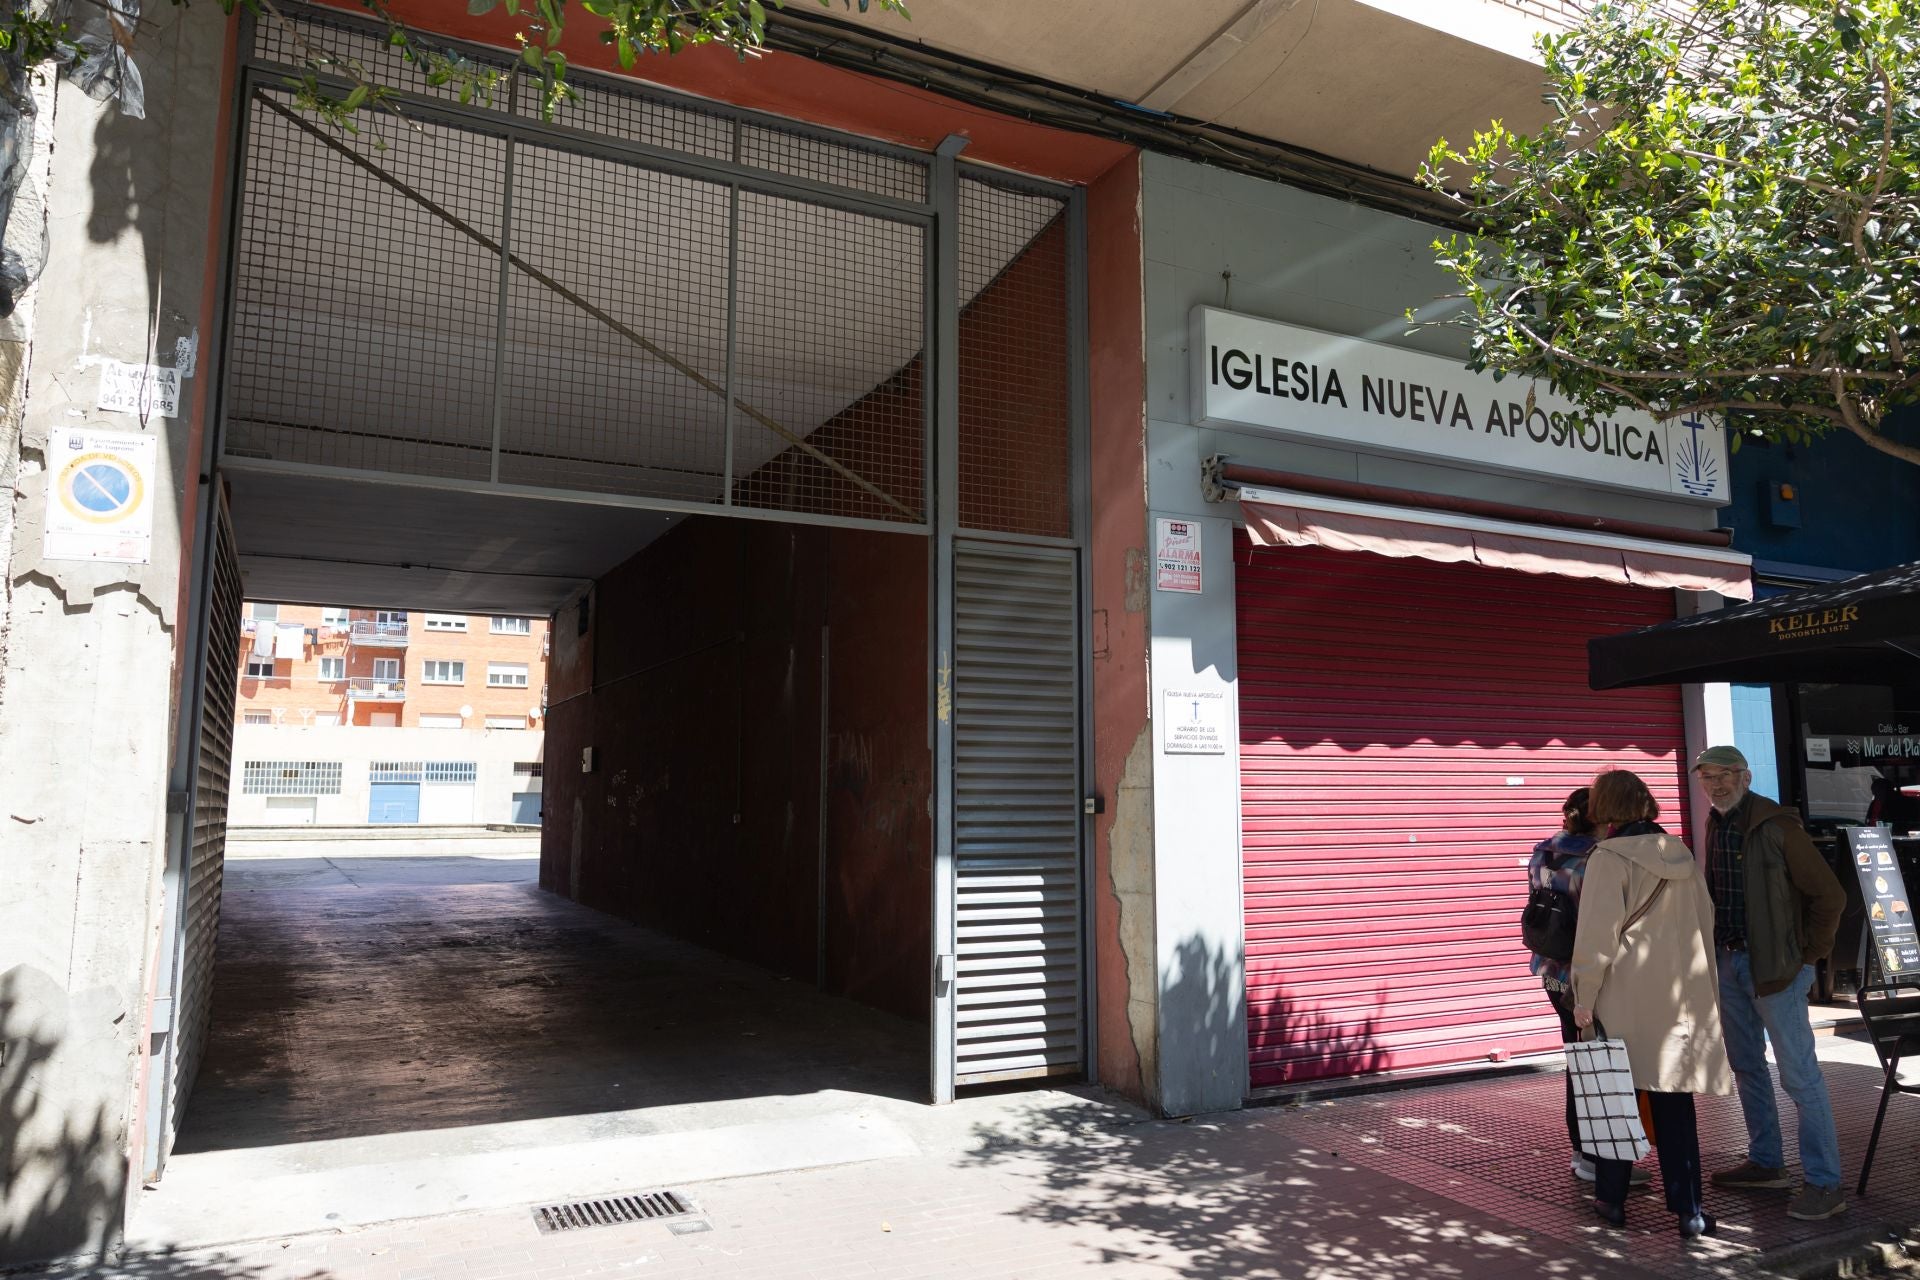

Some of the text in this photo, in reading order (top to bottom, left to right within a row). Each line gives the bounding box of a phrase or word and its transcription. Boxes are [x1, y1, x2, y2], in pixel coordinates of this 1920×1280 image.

[1211, 345, 1347, 408] IGLESIA
[1361, 374, 1474, 431] NUEVA
[103, 393, 173, 412] 941 21 685
[1158, 548, 1200, 561] ALARMA
[1190, 565, 1201, 573] 122
[1769, 605, 1859, 634] KELER
[1778, 627, 1827, 640] DONOSTIA
[1897, 724, 1910, 734] Bar
[1864, 736, 1886, 758] Mar
[1888, 737, 1902, 757] del
